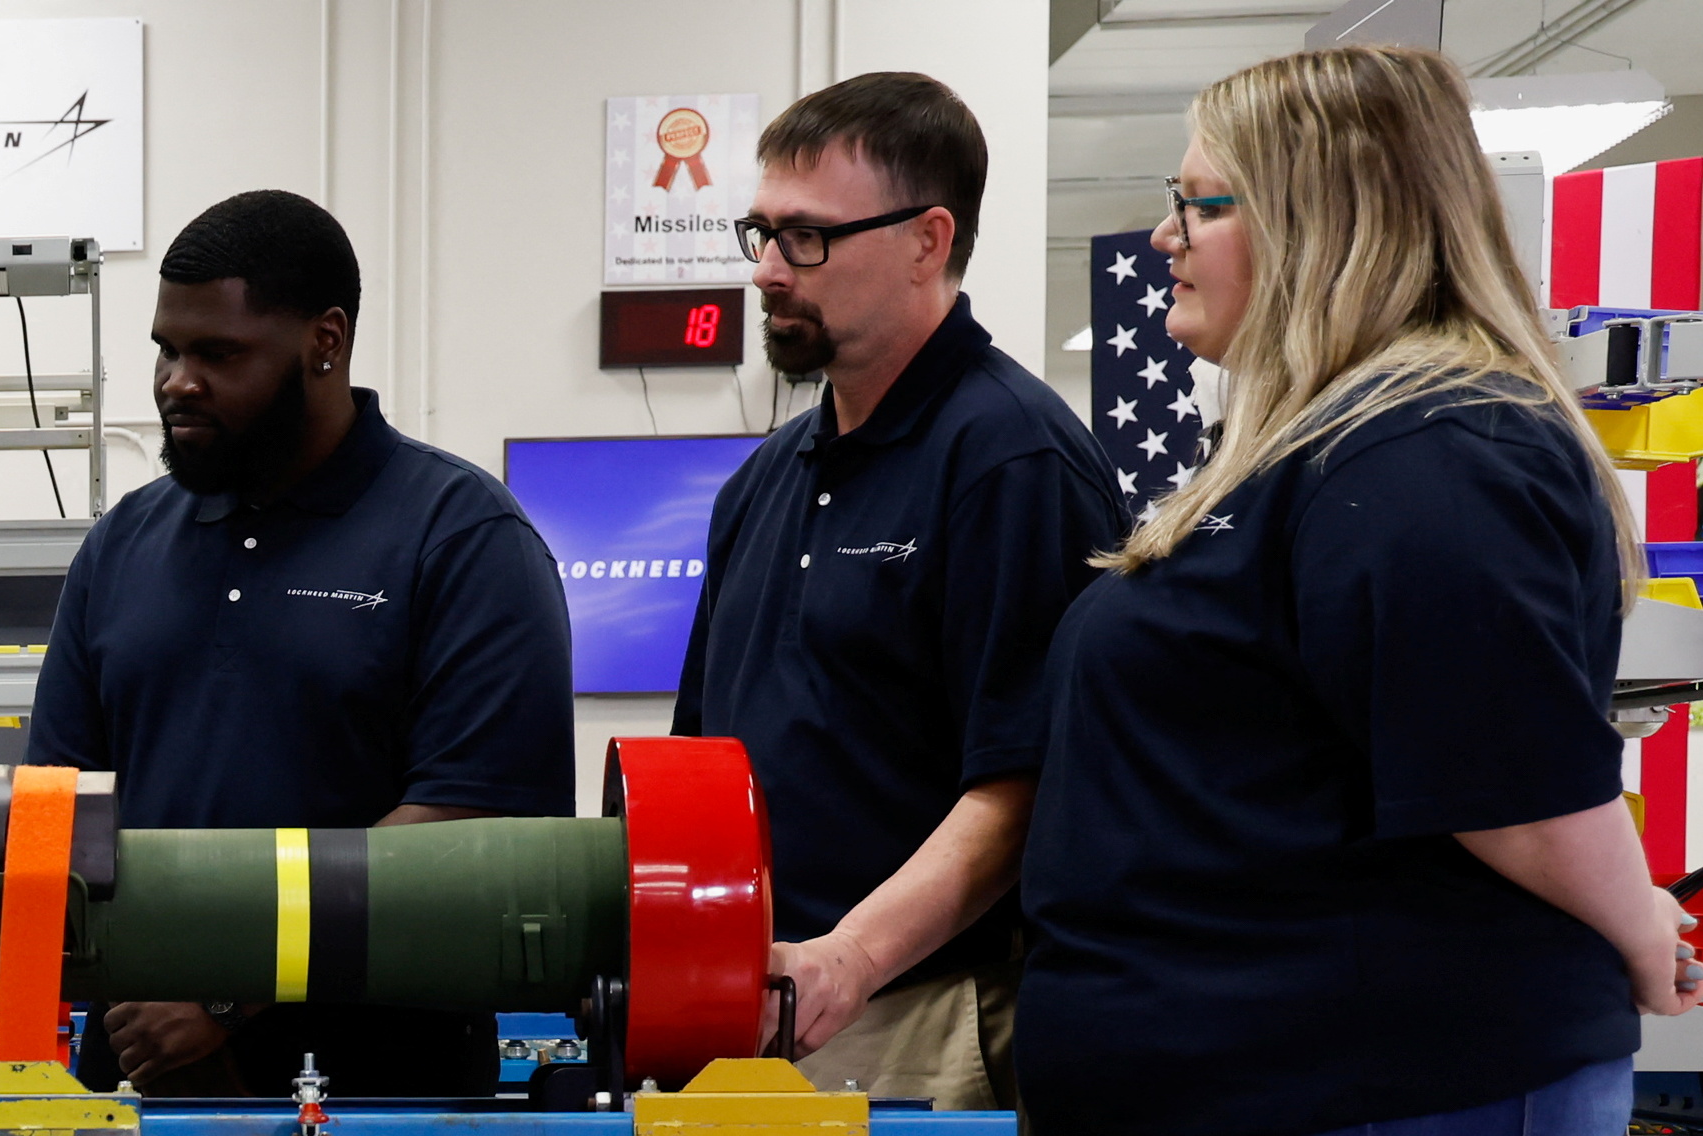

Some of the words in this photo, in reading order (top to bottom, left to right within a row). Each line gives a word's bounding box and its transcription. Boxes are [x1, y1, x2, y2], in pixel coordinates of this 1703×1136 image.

[635, 215, 728, 233] Missiles
[615, 256, 663, 266] Dedicated
[684, 304, 721, 348] 18
[557, 558, 705, 580] LOCKHEED
[287, 588, 329, 598] LOCKHEED
[330, 592, 364, 602] MARTIN
